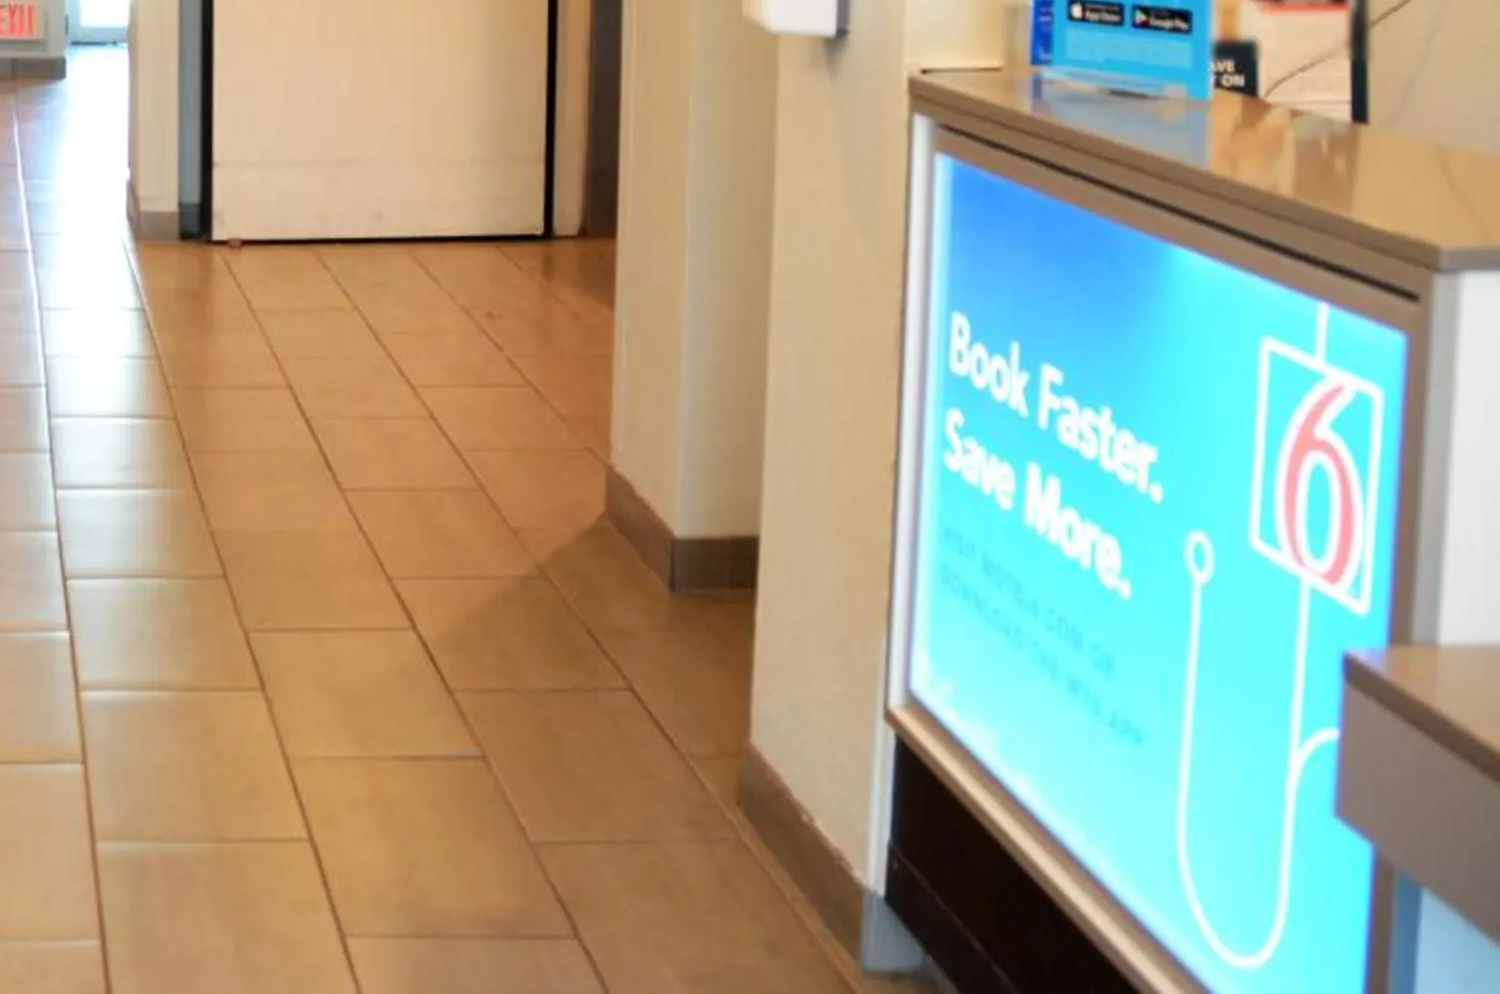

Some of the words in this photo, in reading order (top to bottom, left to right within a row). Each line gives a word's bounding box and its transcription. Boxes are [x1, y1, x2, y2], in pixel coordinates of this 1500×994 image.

[943, 408, 1016, 511] Save
[1023, 461, 1132, 600] More.
[949, 310, 1030, 419] Book
[1037, 362, 1164, 505] Faster.
[1274, 371, 1365, 587] 6
